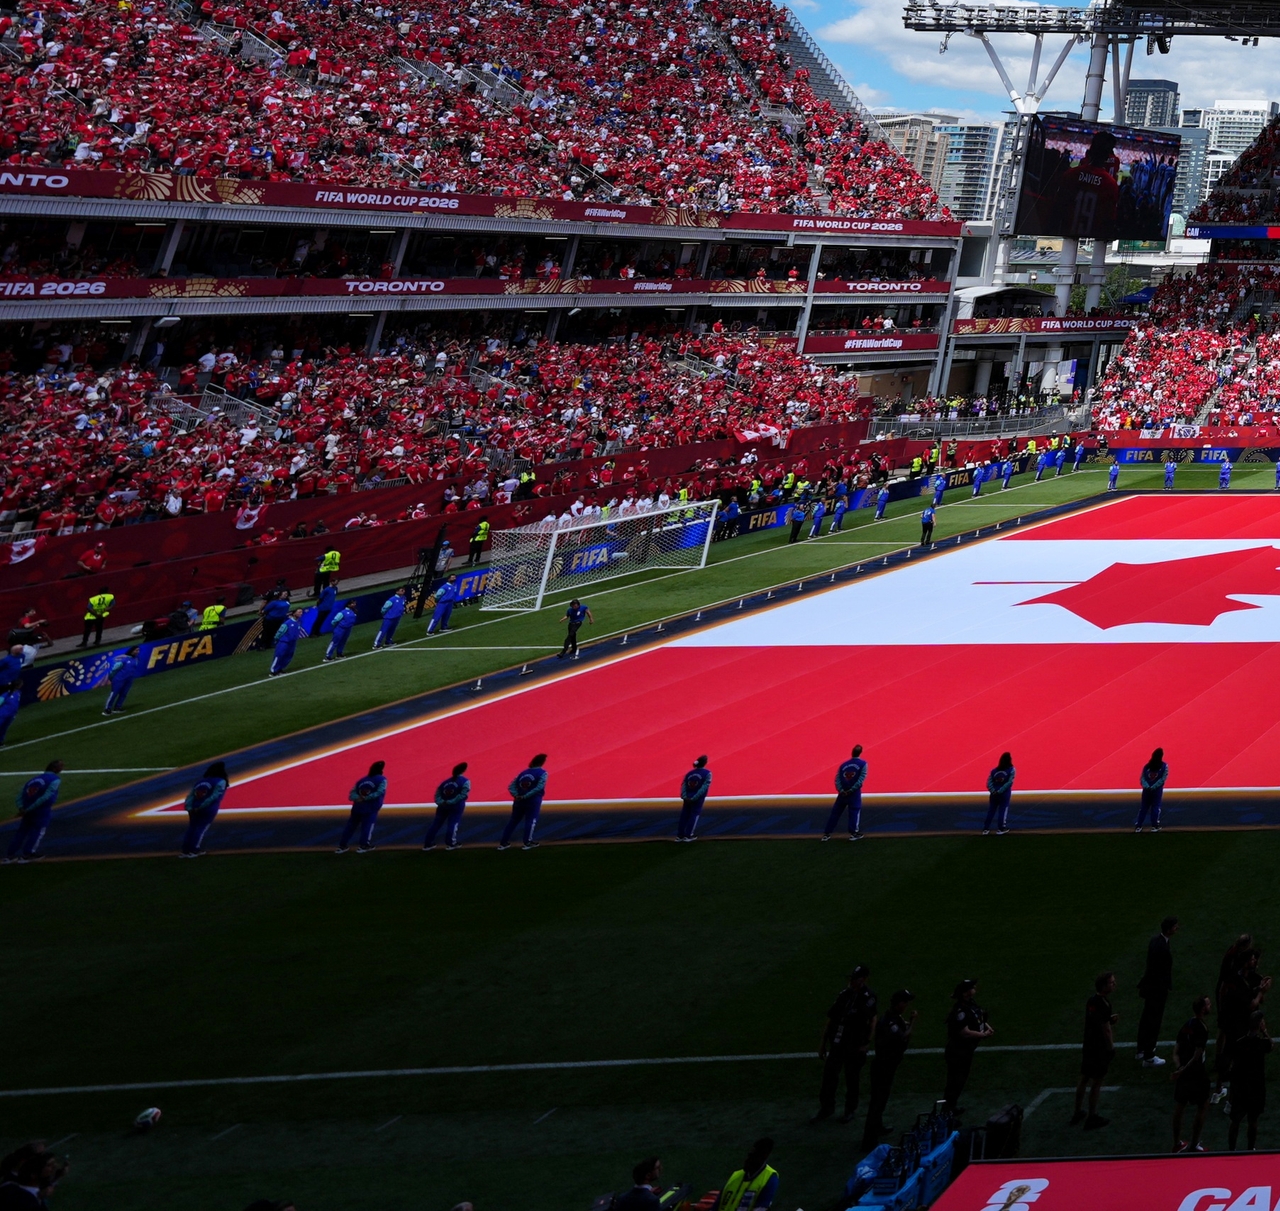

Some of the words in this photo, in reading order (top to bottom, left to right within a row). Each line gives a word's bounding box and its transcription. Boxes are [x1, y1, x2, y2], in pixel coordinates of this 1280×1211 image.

[1078, 172, 1102, 185] DAVIES
[315, 191, 344, 203] FIFA
[346, 193, 392, 206] WORLD
[393, 196, 418, 208] CUP
[418, 197, 459, 209] 2026
[584, 209, 626, 219] #FIFAWorldCup
[793, 219, 814, 228] FIFA
[815, 220, 849, 230] WORLD
[851, 221, 870, 231] CUP
[871, 223, 903, 231] 2026
[1186, 228, 1199, 236] CAN
[39, 282, 107, 295] 2026
[345, 281, 445, 291] TORONTO
[634, 282, 672, 291] #FIFAWorldCup
[846, 282, 921, 291] TORONTO
[1041, 320, 1061, 329] FIFA
[1062, 320, 1093, 330] WORLD
[1095, 320, 1113, 329] CUP
[844, 338, 902, 349] #FIFAWorldCup
[1126, 451, 1154, 461] FIFA
[1201, 450, 1227, 460] FIFA
[949, 475, 970, 487] FIFA
[750, 511, 777, 529] FIFA
[573, 547, 609, 570] FIFA
[147, 635, 214, 668] FIFA
